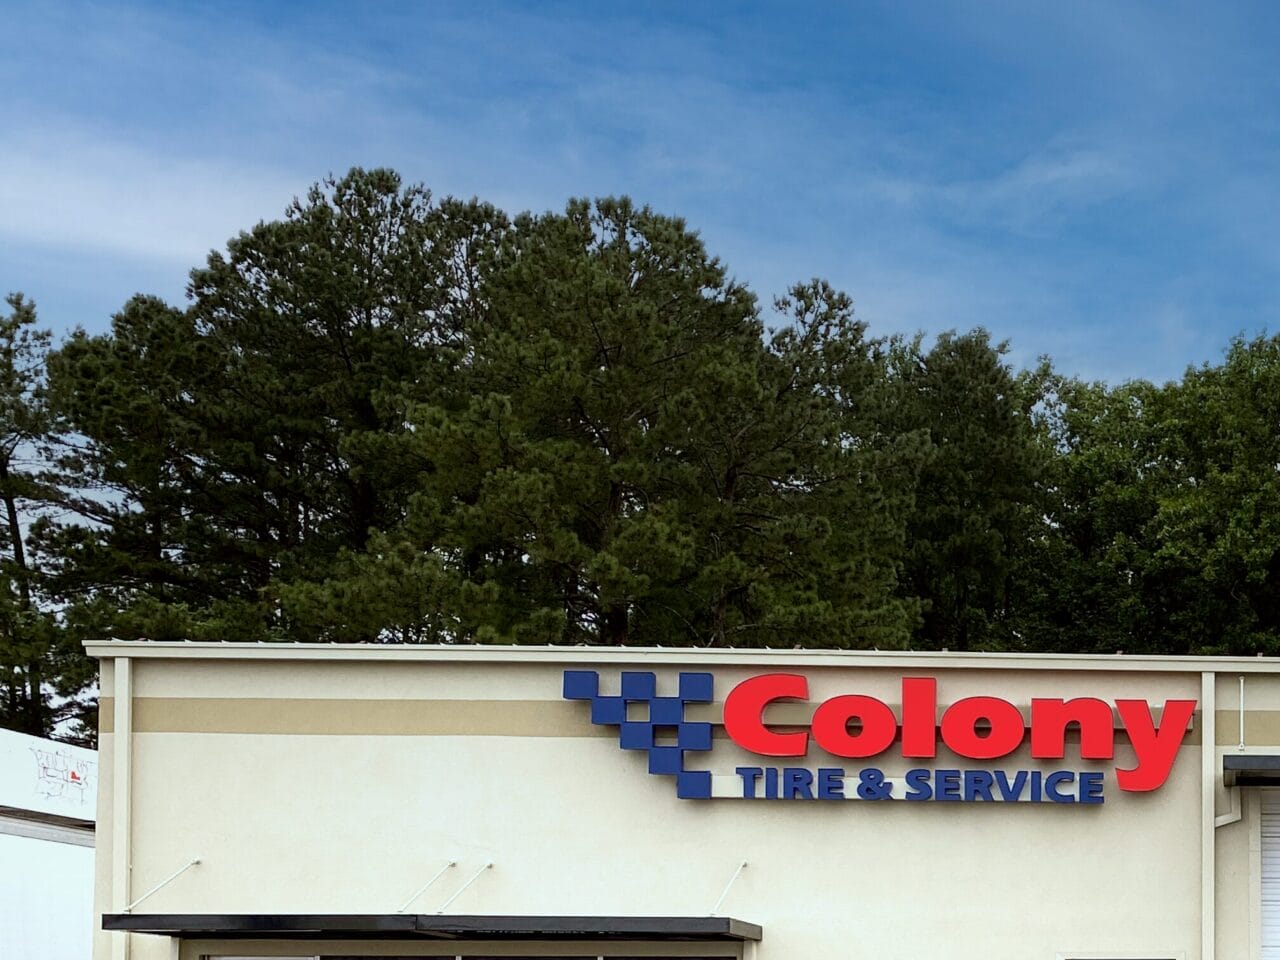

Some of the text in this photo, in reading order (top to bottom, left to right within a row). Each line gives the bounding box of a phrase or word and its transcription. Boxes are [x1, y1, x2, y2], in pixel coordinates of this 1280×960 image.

[724, 673, 1198, 792] Colony
[735, 766, 1105, 804] TIRE & SERVICE
